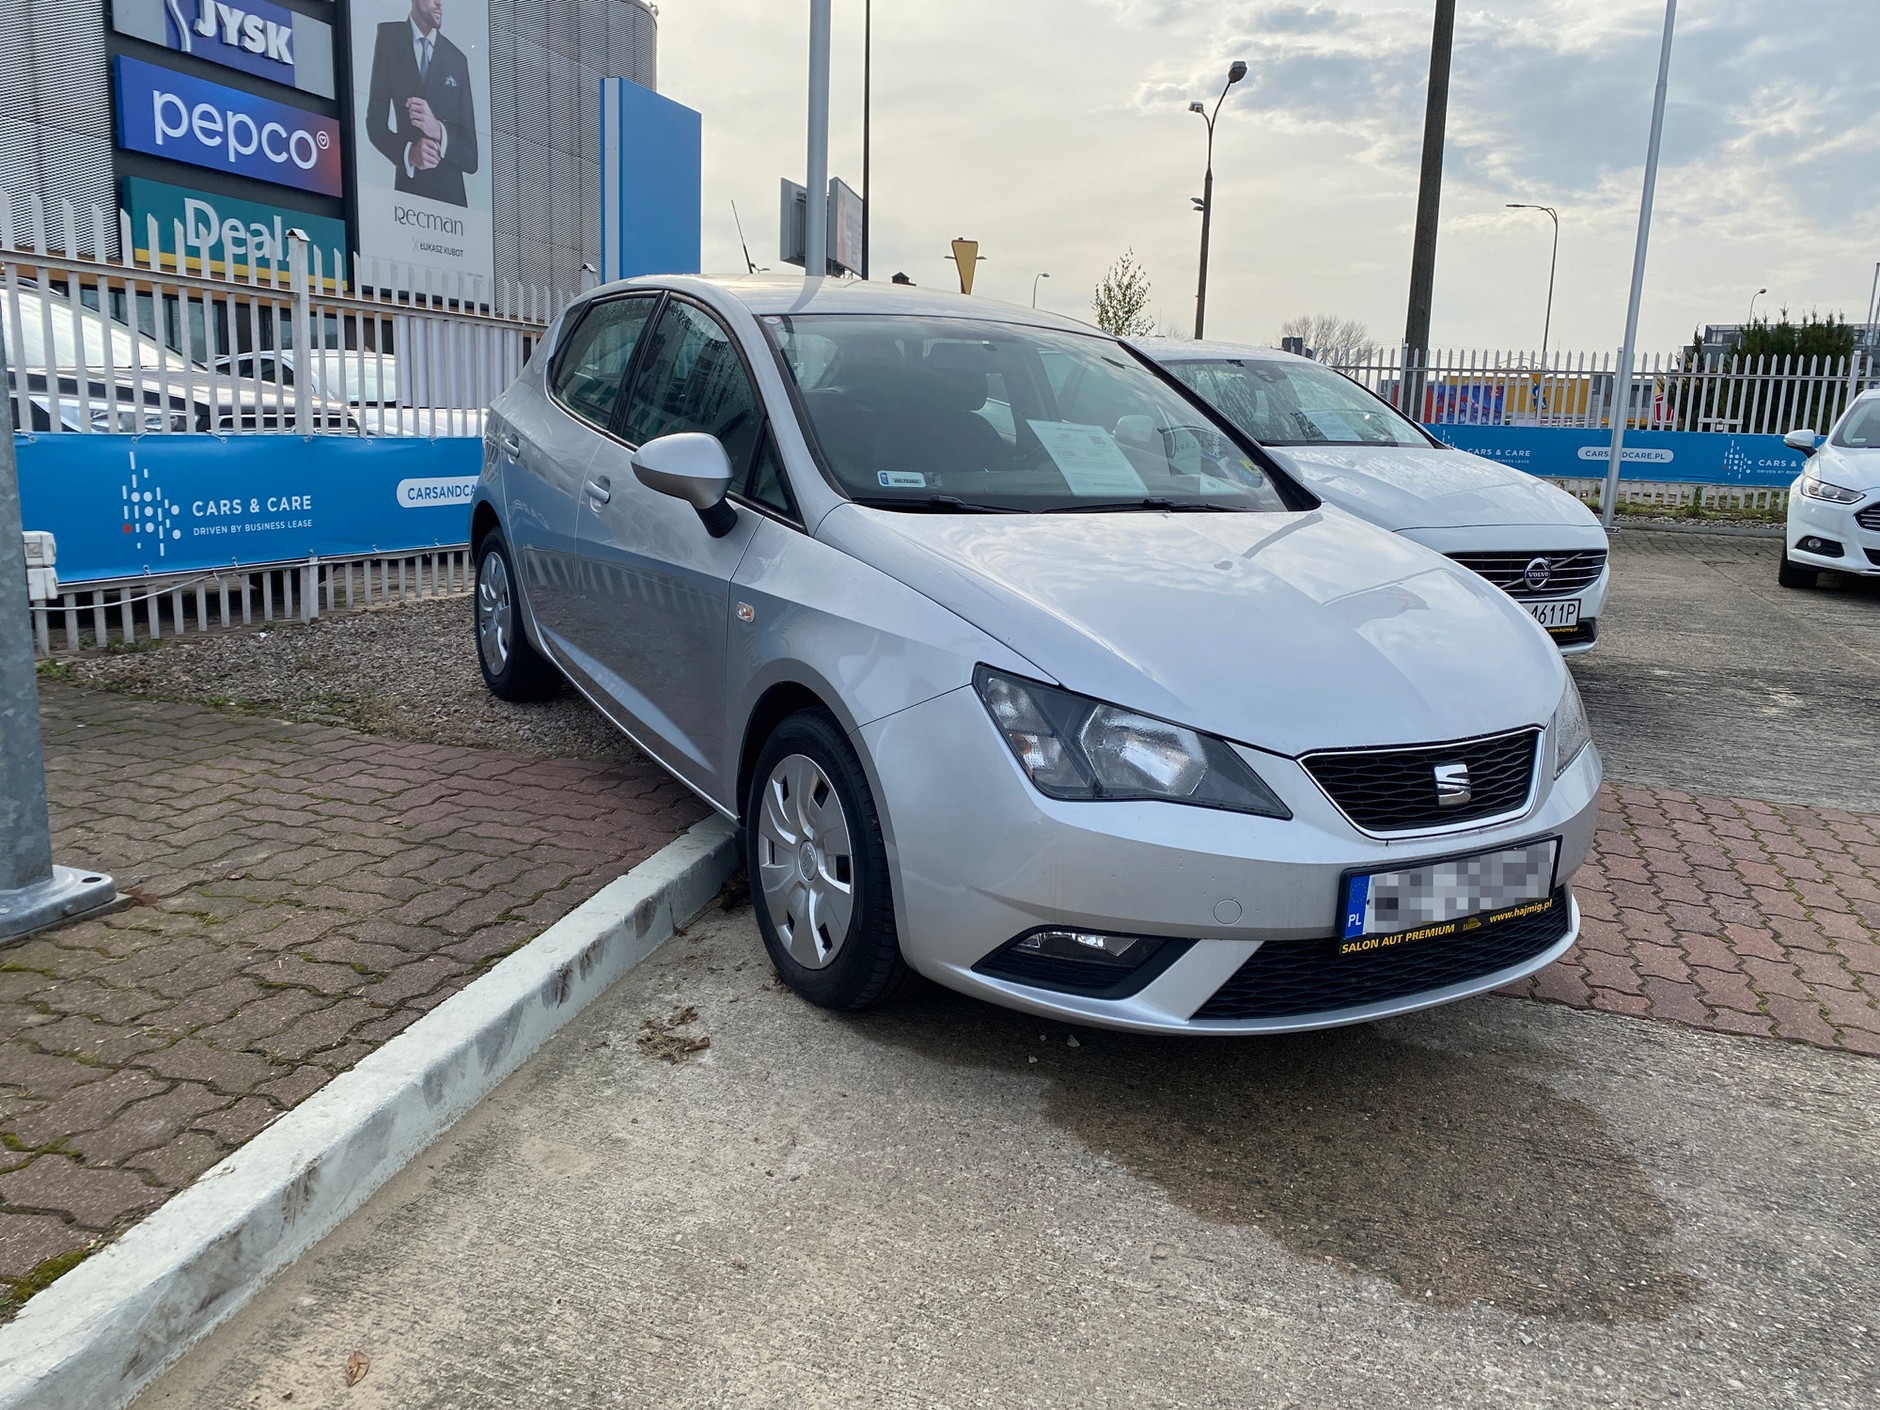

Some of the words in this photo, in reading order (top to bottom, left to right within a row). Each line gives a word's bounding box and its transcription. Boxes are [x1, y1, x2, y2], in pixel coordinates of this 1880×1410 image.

[193, 0, 294, 65] JYSK
[152, 90, 318, 170] pepco
[184, 198, 291, 262] Deal
[420, 241, 443, 254] ŁUKASZ
[443, 247, 465, 258] KUBOT
[1467, 448, 1492, 456] CARS
[1505, 449, 1531, 457] CARE
[1585, 450, 1666, 460] CARSDCARE.PL
[1758, 459, 1787, 467] CARS
[192, 499, 242, 516] CARS
[249, 498, 260, 514] &
[266, 495, 312, 512] CARE
[193, 526, 228, 536] DRIVEN
[230, 524, 242, 534] BY
[244, 521, 285, 532] BUSINESS
[287, 519, 312, 529] LEASE
[1341, 939, 1379, 954] SALON
[1381, 934, 1404, 947] AUT
[1405, 923, 1456, 942] PREMIUM
[1489, 899, 1553, 923] www.hajmig.pl
[1347, 913, 1362, 928] PL
